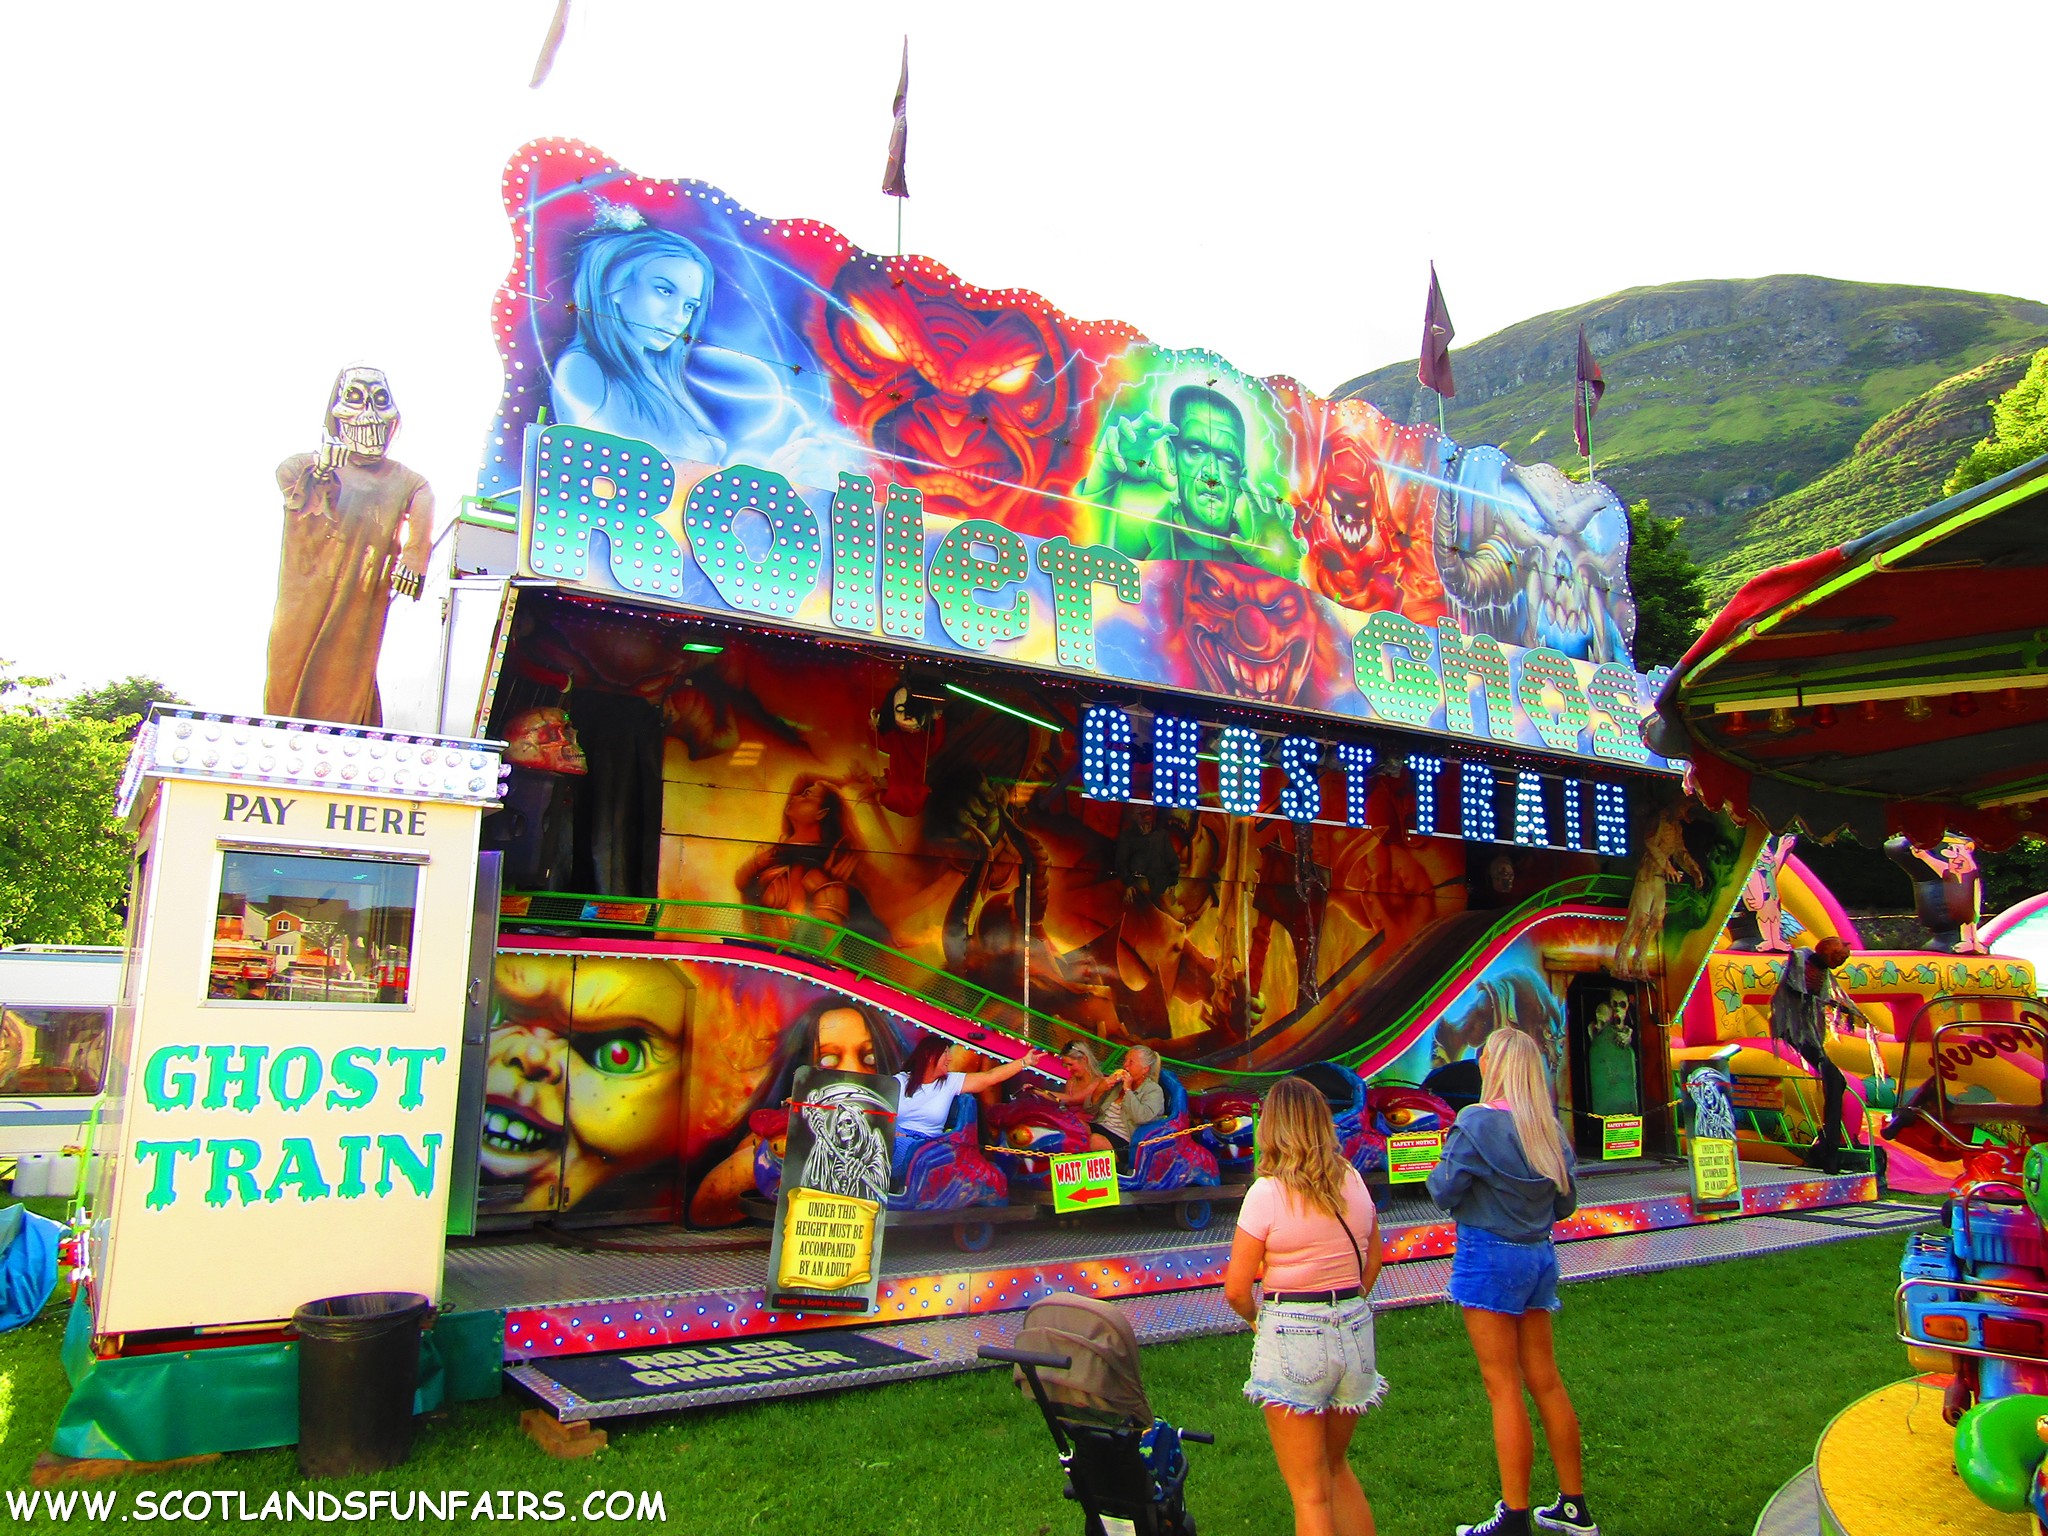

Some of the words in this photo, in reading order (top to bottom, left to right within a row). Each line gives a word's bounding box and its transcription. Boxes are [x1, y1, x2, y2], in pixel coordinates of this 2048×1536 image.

[530, 424, 1143, 669] Roller
[1351, 609, 1687, 771] Ghos
[1082, 704, 1375, 828] GHOST
[1406, 753, 1627, 856] TRAIN
[223, 793, 298, 825] PAY
[326, 803, 427, 837] HERE
[143, 1045, 446, 1113] GHOST
[135, 1133, 443, 1211] TRAIN
[1055, 1161, 1082, 1185] WAIT
[1086, 1157, 1112, 1181] HERE
[808, 1202, 836, 1218] UNDER
[837, 1204, 857, 1220] THIS
[795, 1221, 828, 1237] HEIGHT
[828, 1223, 852, 1239] MUST
[852, 1224, 864, 1240] BE
[799, 1241, 856, 1258] ACCOMPANIED
[799, 1260, 810, 1275] BY
[811, 1261, 824, 1276] AN
[824, 1262, 851, 1277] ADULT
[619, 1340, 806, 1370] ROLLER
